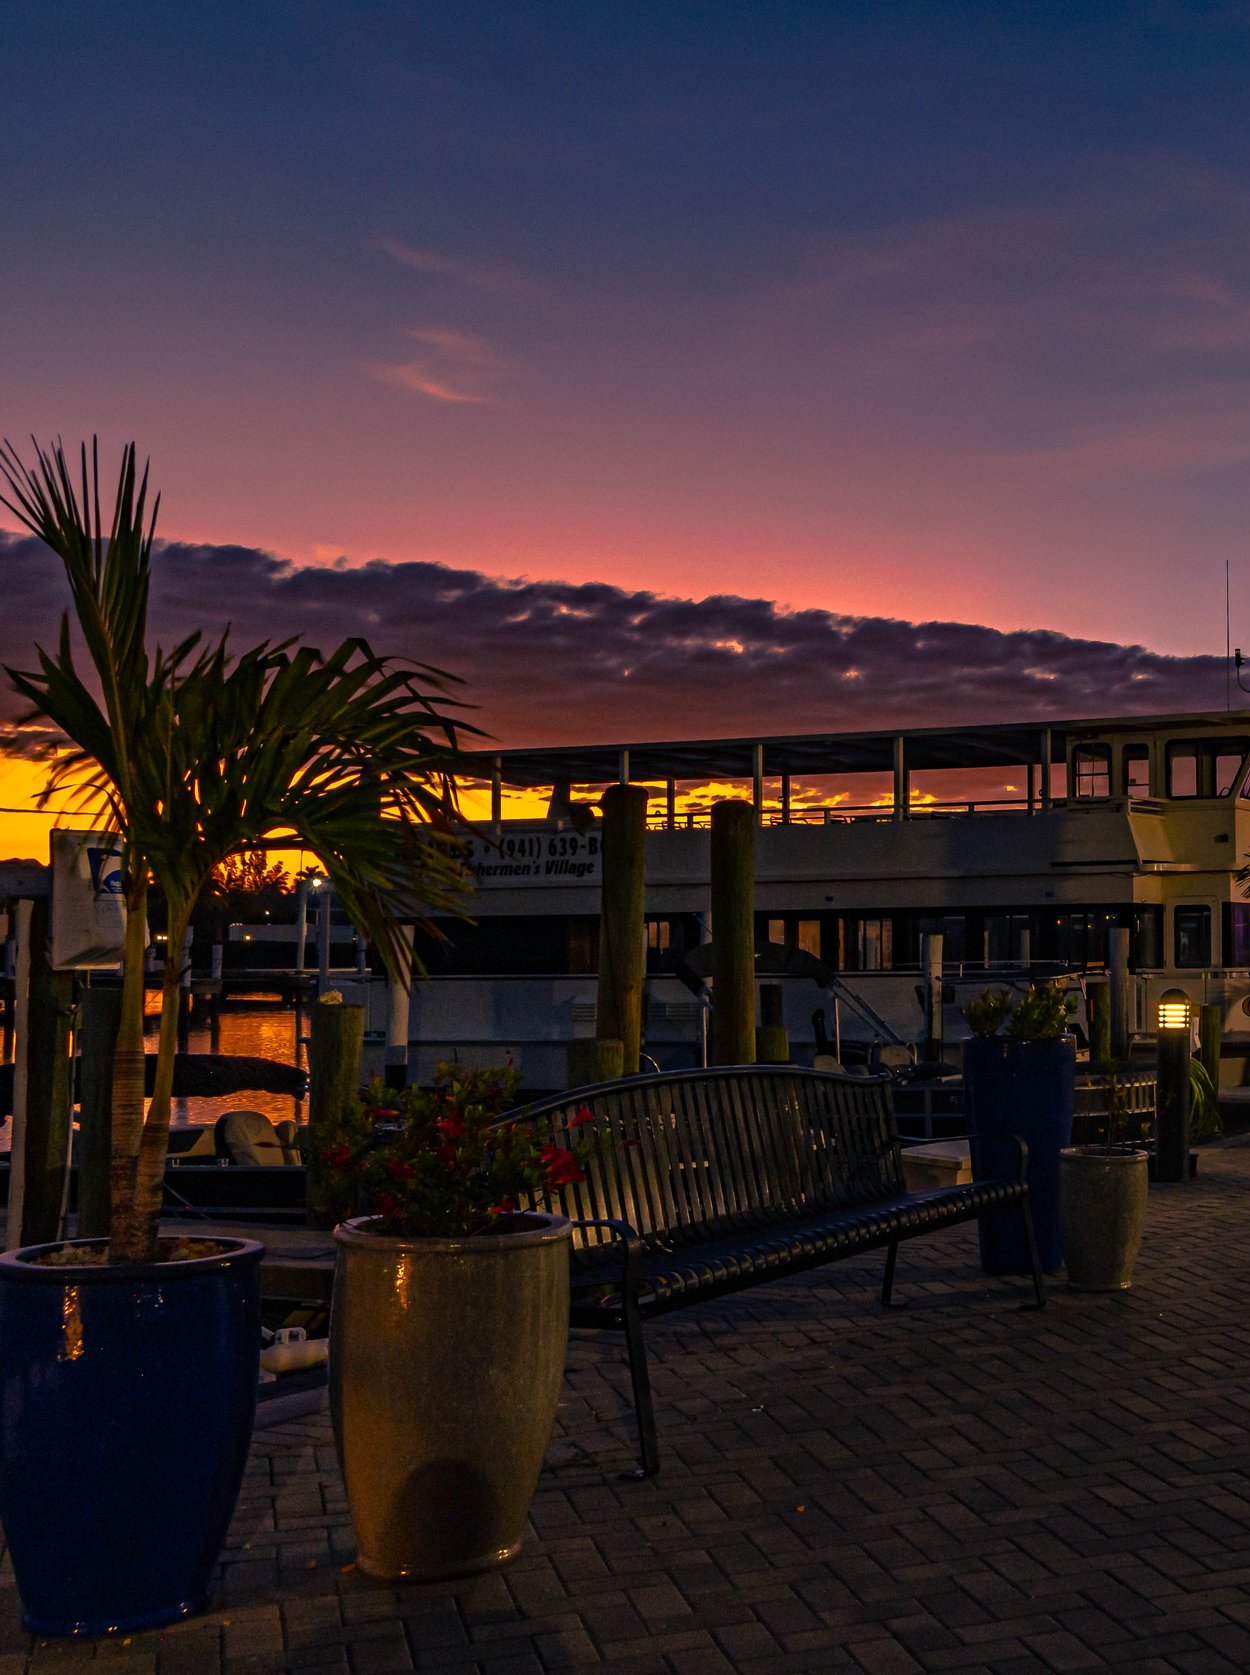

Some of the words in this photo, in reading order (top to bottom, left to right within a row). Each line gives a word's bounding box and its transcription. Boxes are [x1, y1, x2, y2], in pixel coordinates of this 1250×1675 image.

[499, 837, 541, 859] (941)
[549, 836, 604, 857] 639-B
[469, 860, 540, 877] hermen's
[545, 860, 595, 877] Village
